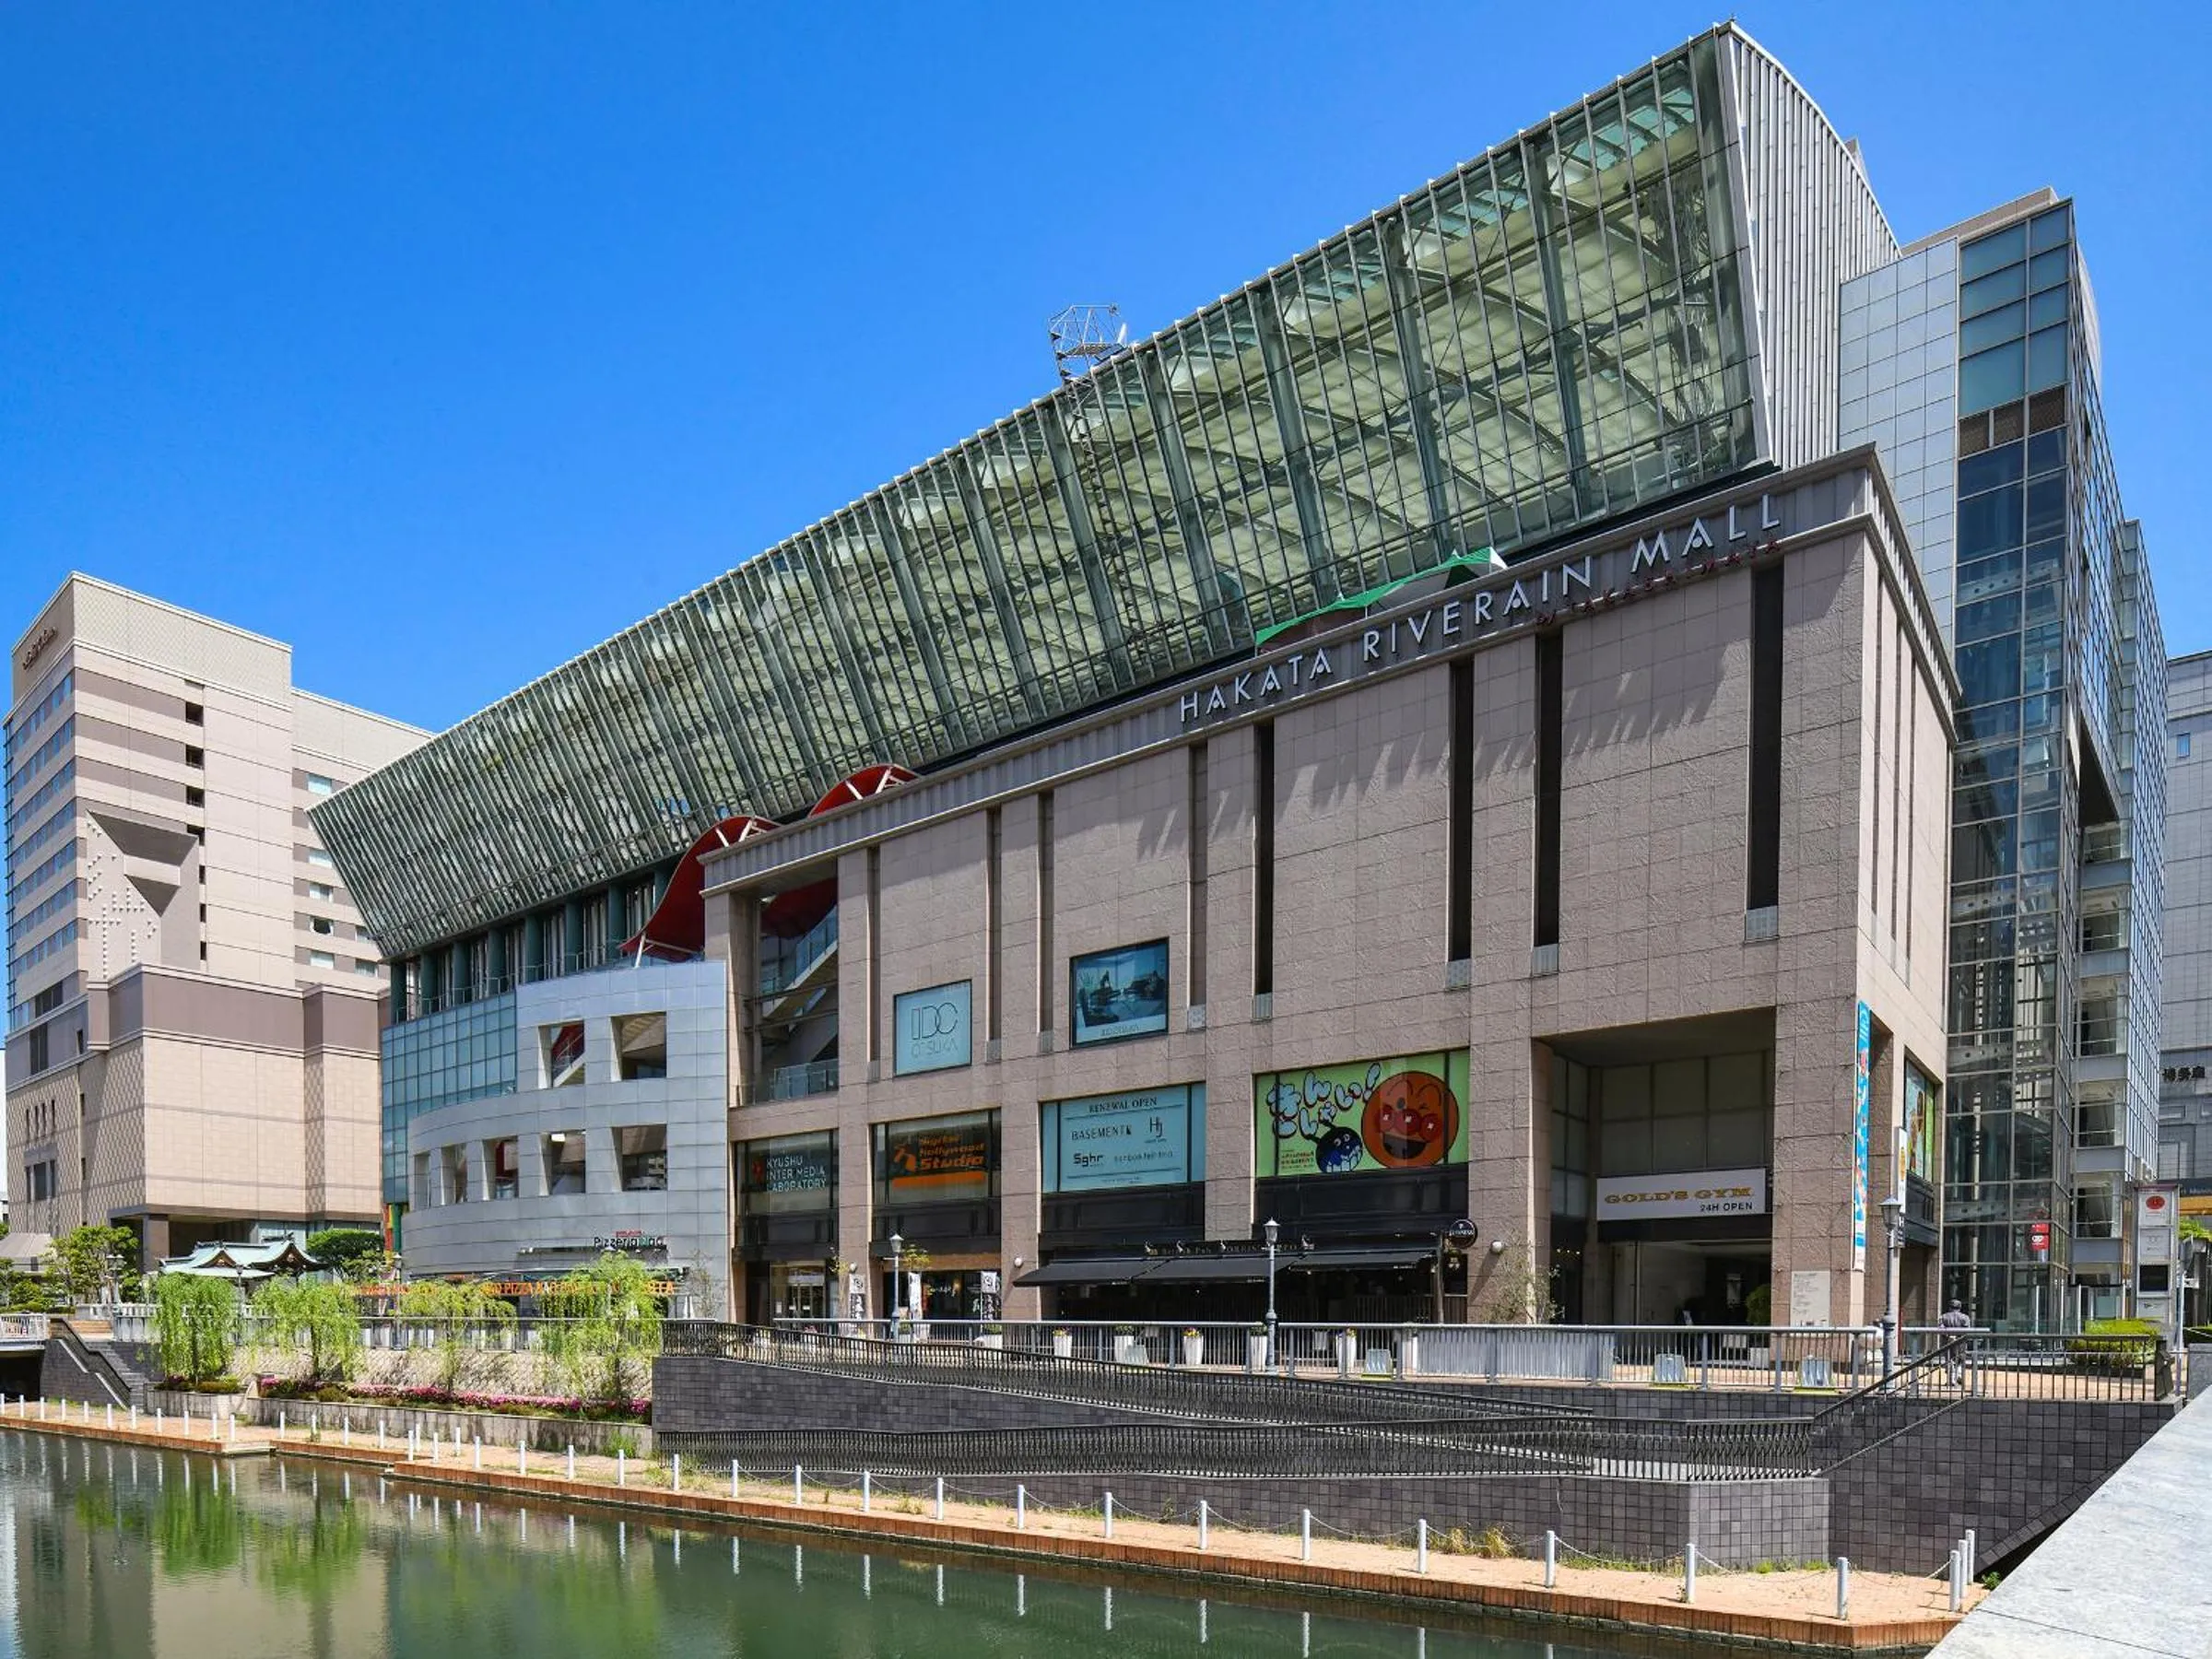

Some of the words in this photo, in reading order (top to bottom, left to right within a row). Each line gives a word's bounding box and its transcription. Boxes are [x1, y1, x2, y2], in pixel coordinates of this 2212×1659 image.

[1180, 648, 1333, 723] HAKATA
[1363, 556, 1592, 662] RIVERAIN
[1630, 493, 1781, 573] MALL
[911, 1002, 959, 1041] IDC
[1088, 1100, 1128, 1113] RENEWAL
[1131, 1097, 1158, 1108] OPEN
[767, 1155, 804, 1170] KYUSHU
[1073, 1151, 1104, 1168] Sghr
[767, 1167, 794, 1181] INTER
[796, 1164, 827, 1179] MEDIA
[767, 1177, 827, 1193] LABORATORY
[1604, 1190, 1688, 1205] GOLD'S
[1694, 1186, 1754, 1199] GYM
[1700, 1203, 1719, 1213] 24H
[1723, 1201, 1753, 1212] OPEN
